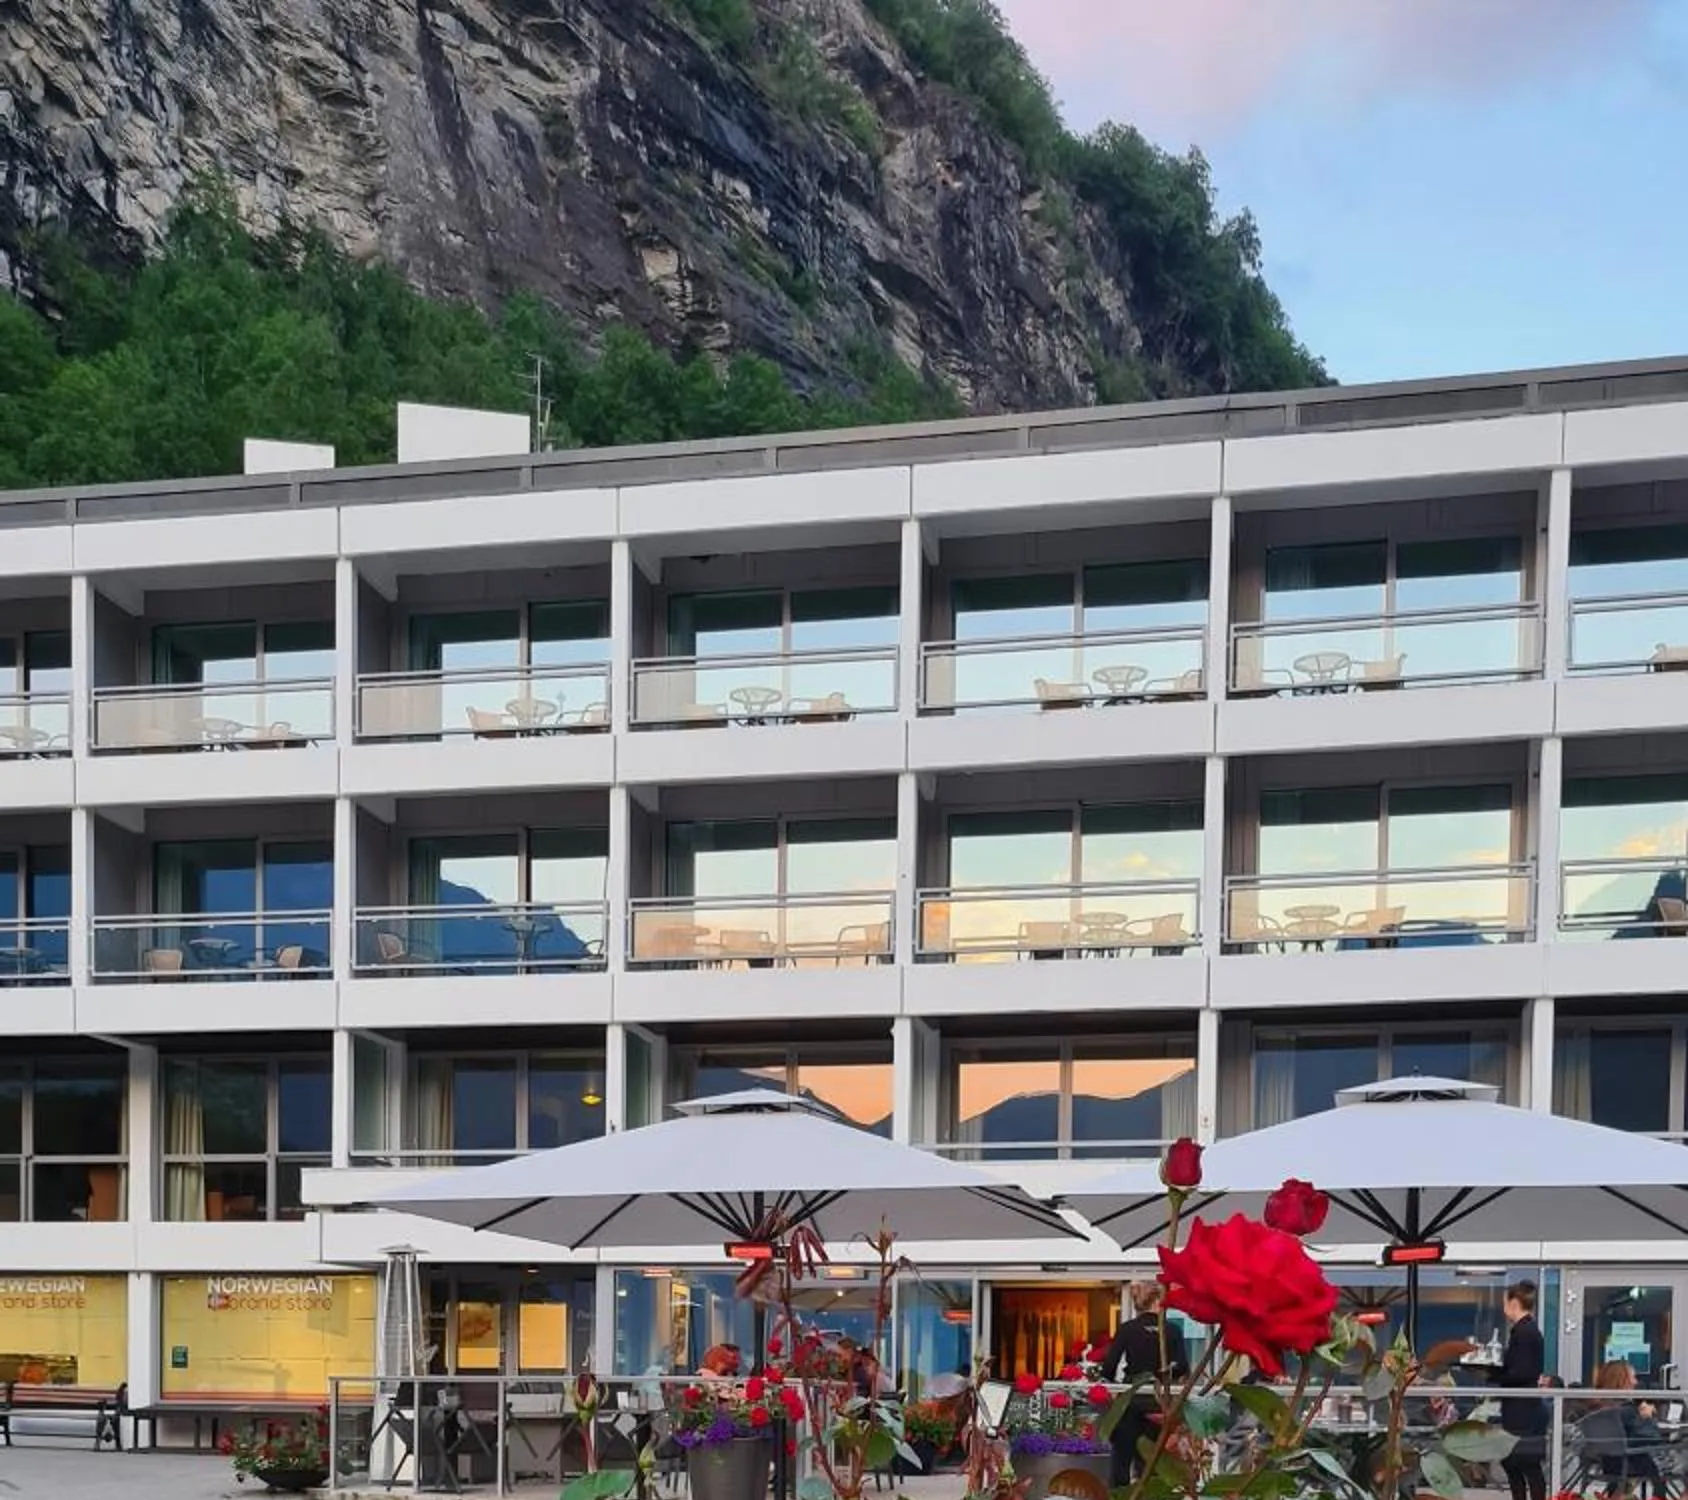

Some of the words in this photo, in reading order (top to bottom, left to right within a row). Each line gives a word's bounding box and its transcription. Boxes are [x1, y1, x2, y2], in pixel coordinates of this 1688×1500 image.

[207, 1277, 333, 1294] NORWEGIAN
[42, 1294, 86, 1309] store
[285, 1295, 333, 1311] store
